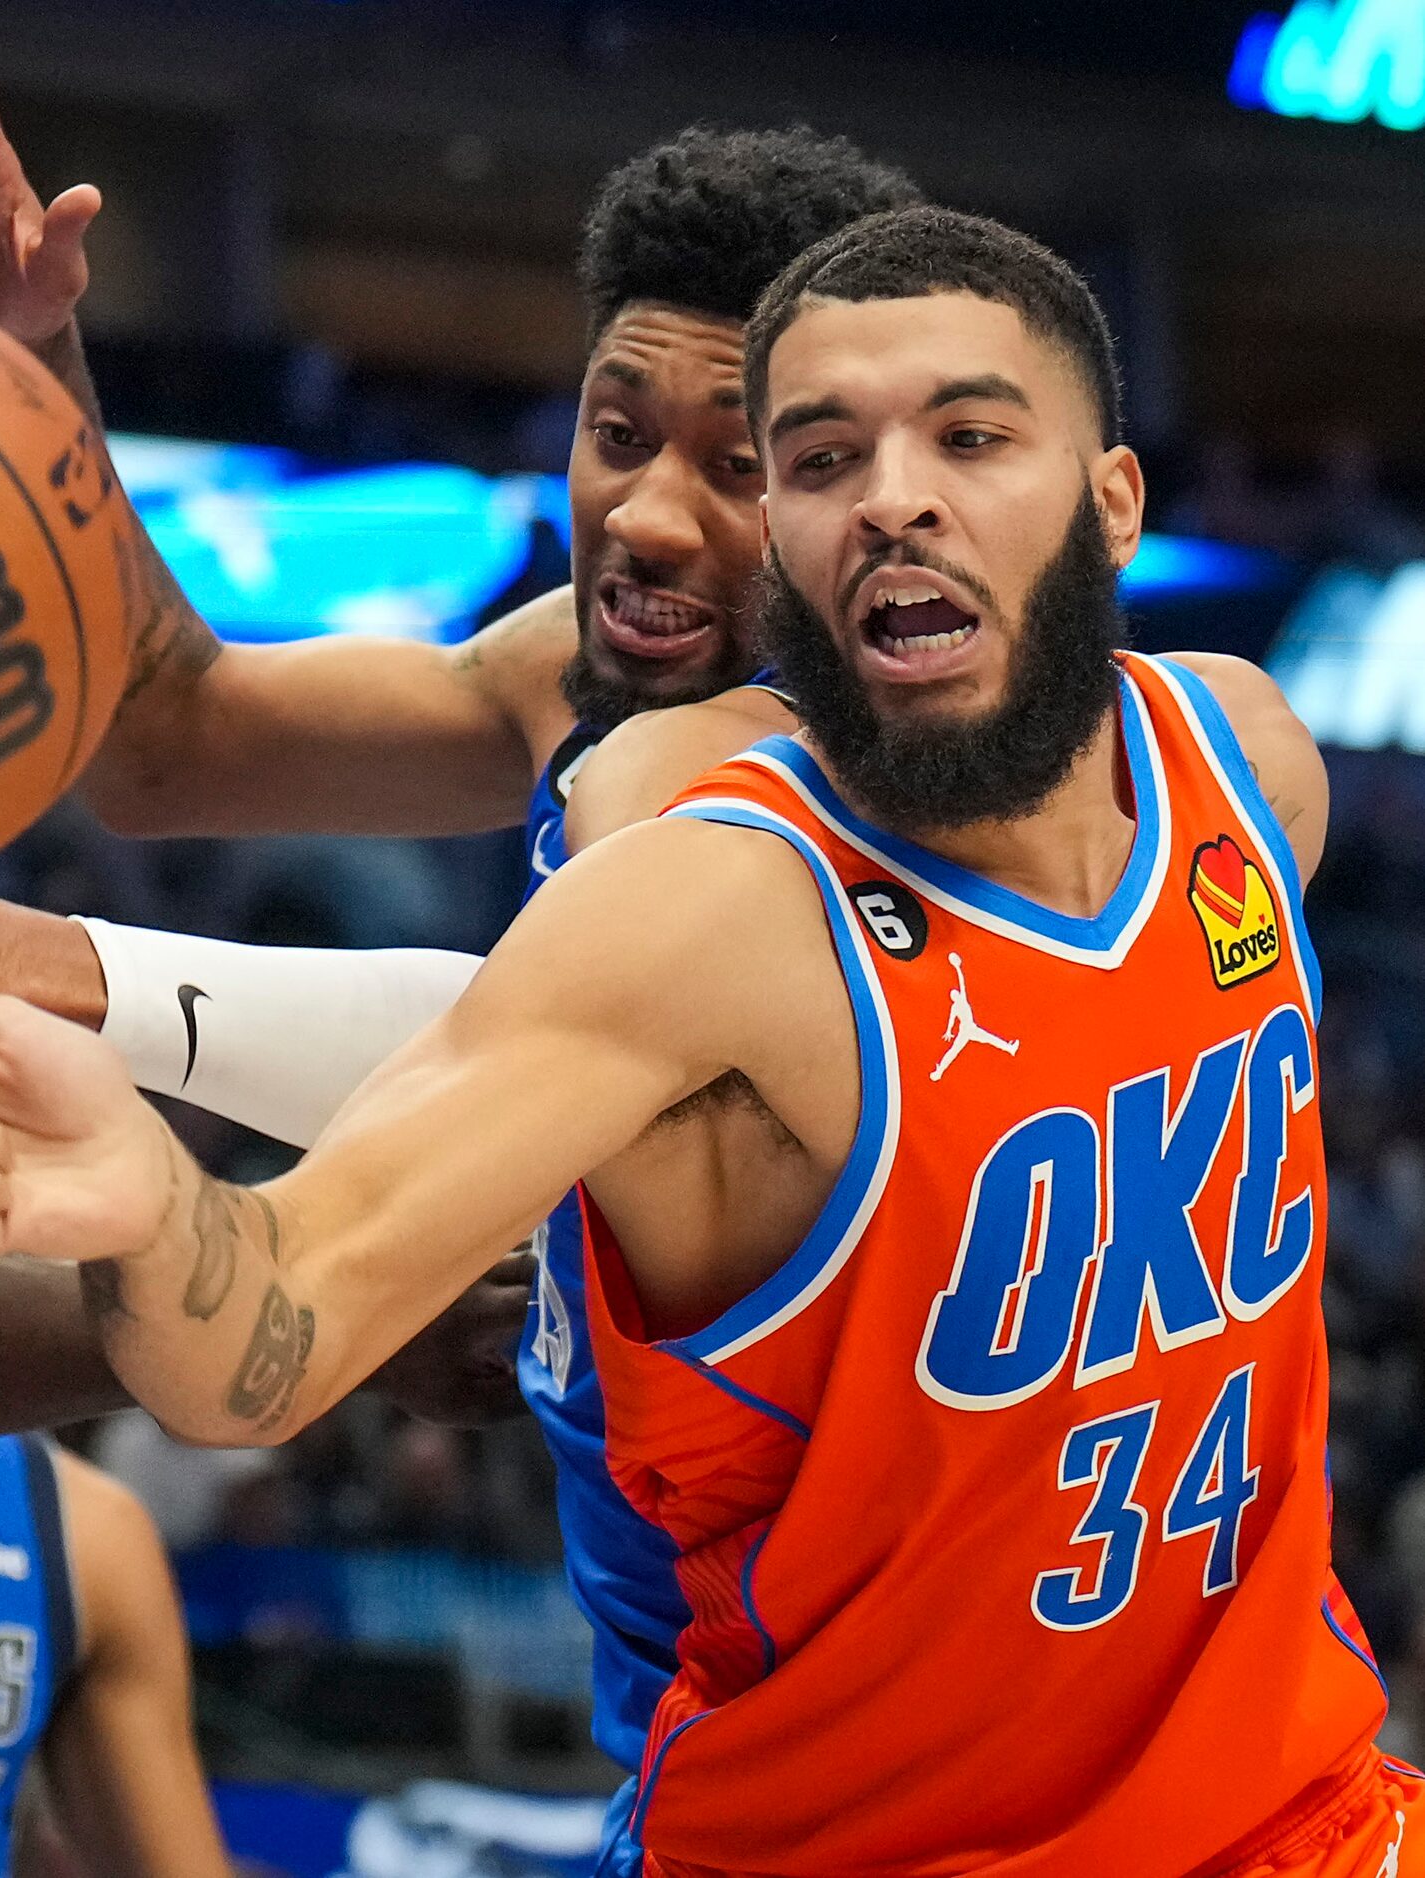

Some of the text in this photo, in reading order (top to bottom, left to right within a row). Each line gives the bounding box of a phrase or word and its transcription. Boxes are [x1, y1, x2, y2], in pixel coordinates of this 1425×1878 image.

[856, 893, 913, 950] 6
[915, 1003, 1315, 1412] OKC
[1030, 1362, 1261, 1632] 34
